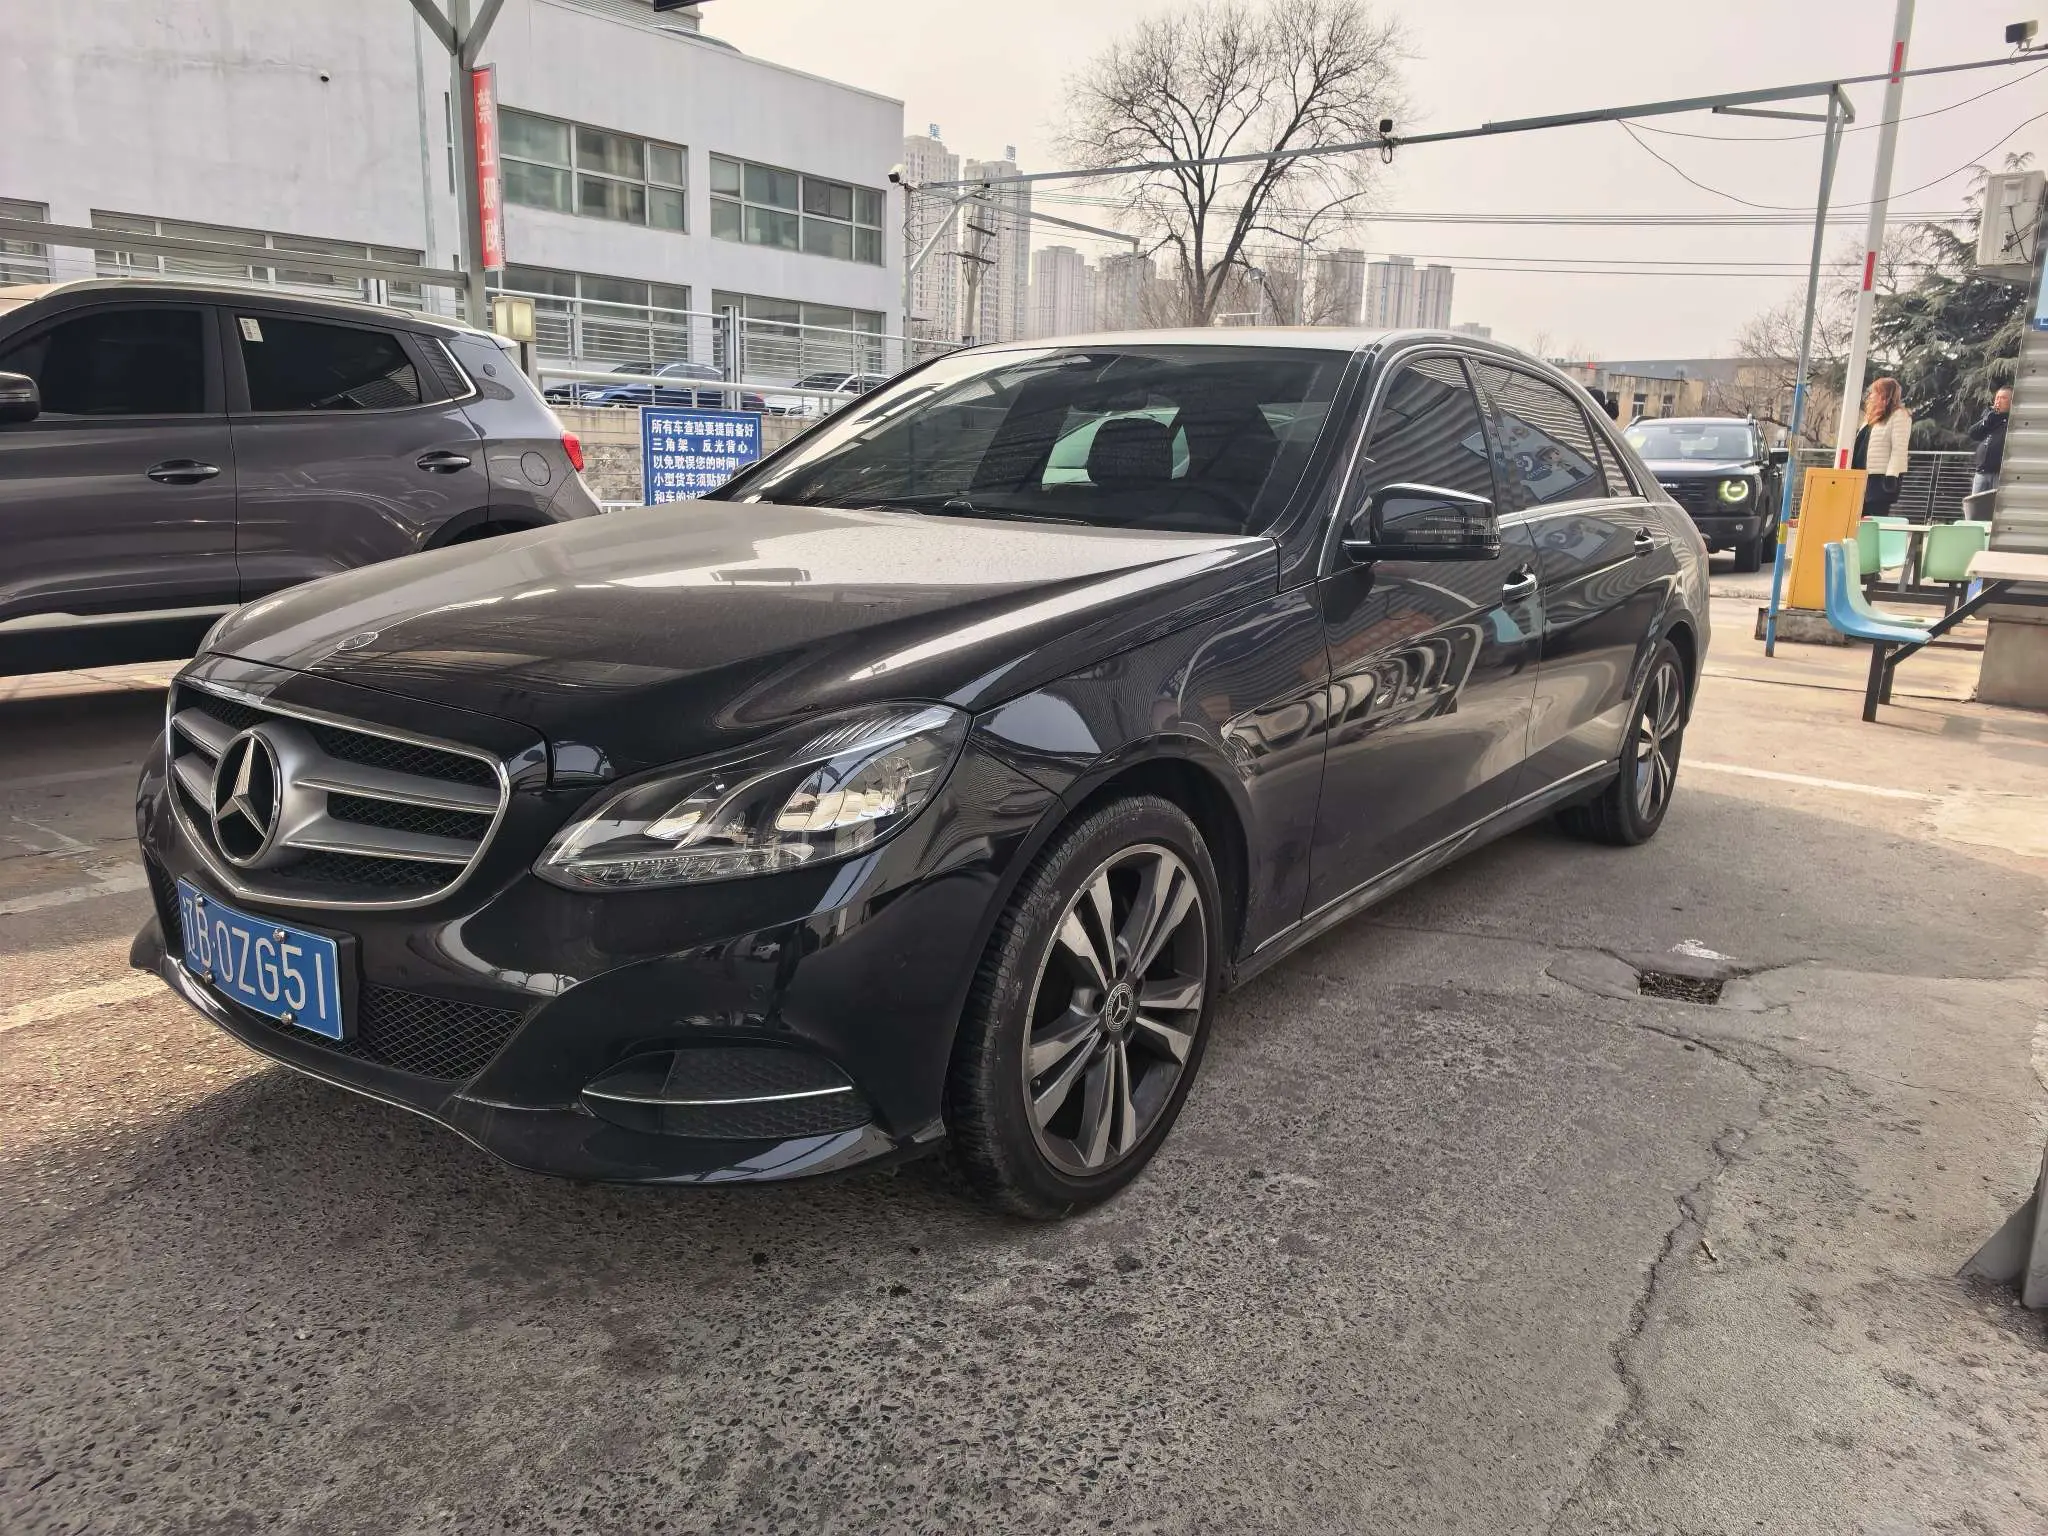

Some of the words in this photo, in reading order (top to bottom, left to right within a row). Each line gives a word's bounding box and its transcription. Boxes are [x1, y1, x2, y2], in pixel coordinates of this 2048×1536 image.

[476, 88, 500, 252] 禁止吸烟
[651, 419, 755, 437] 所有车查验要提前备好
[653, 472, 731, 487] 小型货车须贴好
